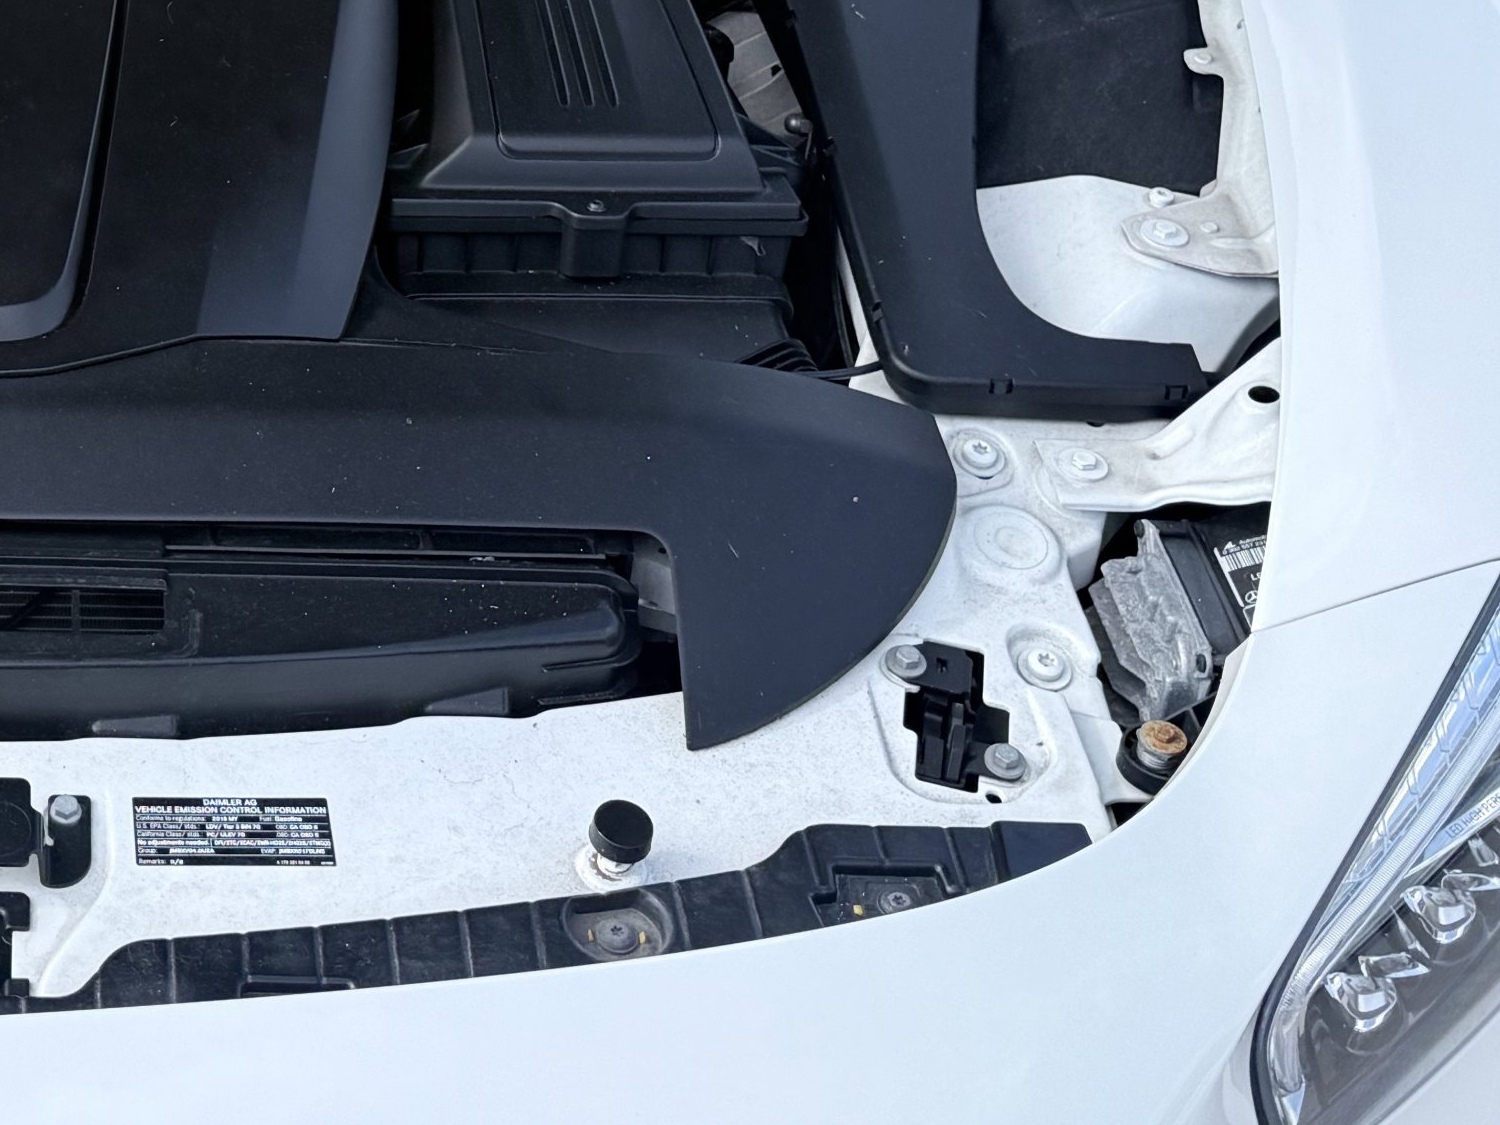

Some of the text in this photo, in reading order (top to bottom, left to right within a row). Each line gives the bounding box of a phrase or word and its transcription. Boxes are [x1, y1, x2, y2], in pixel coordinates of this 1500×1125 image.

[202, 798, 258, 806] DAIMLER AG
[134, 806, 327, 814] VEHICLE EMISSION CONTROL INFORMATION
[1445, 823, 1464, 838] LED
[1461, 807, 1485, 827] HIGH
